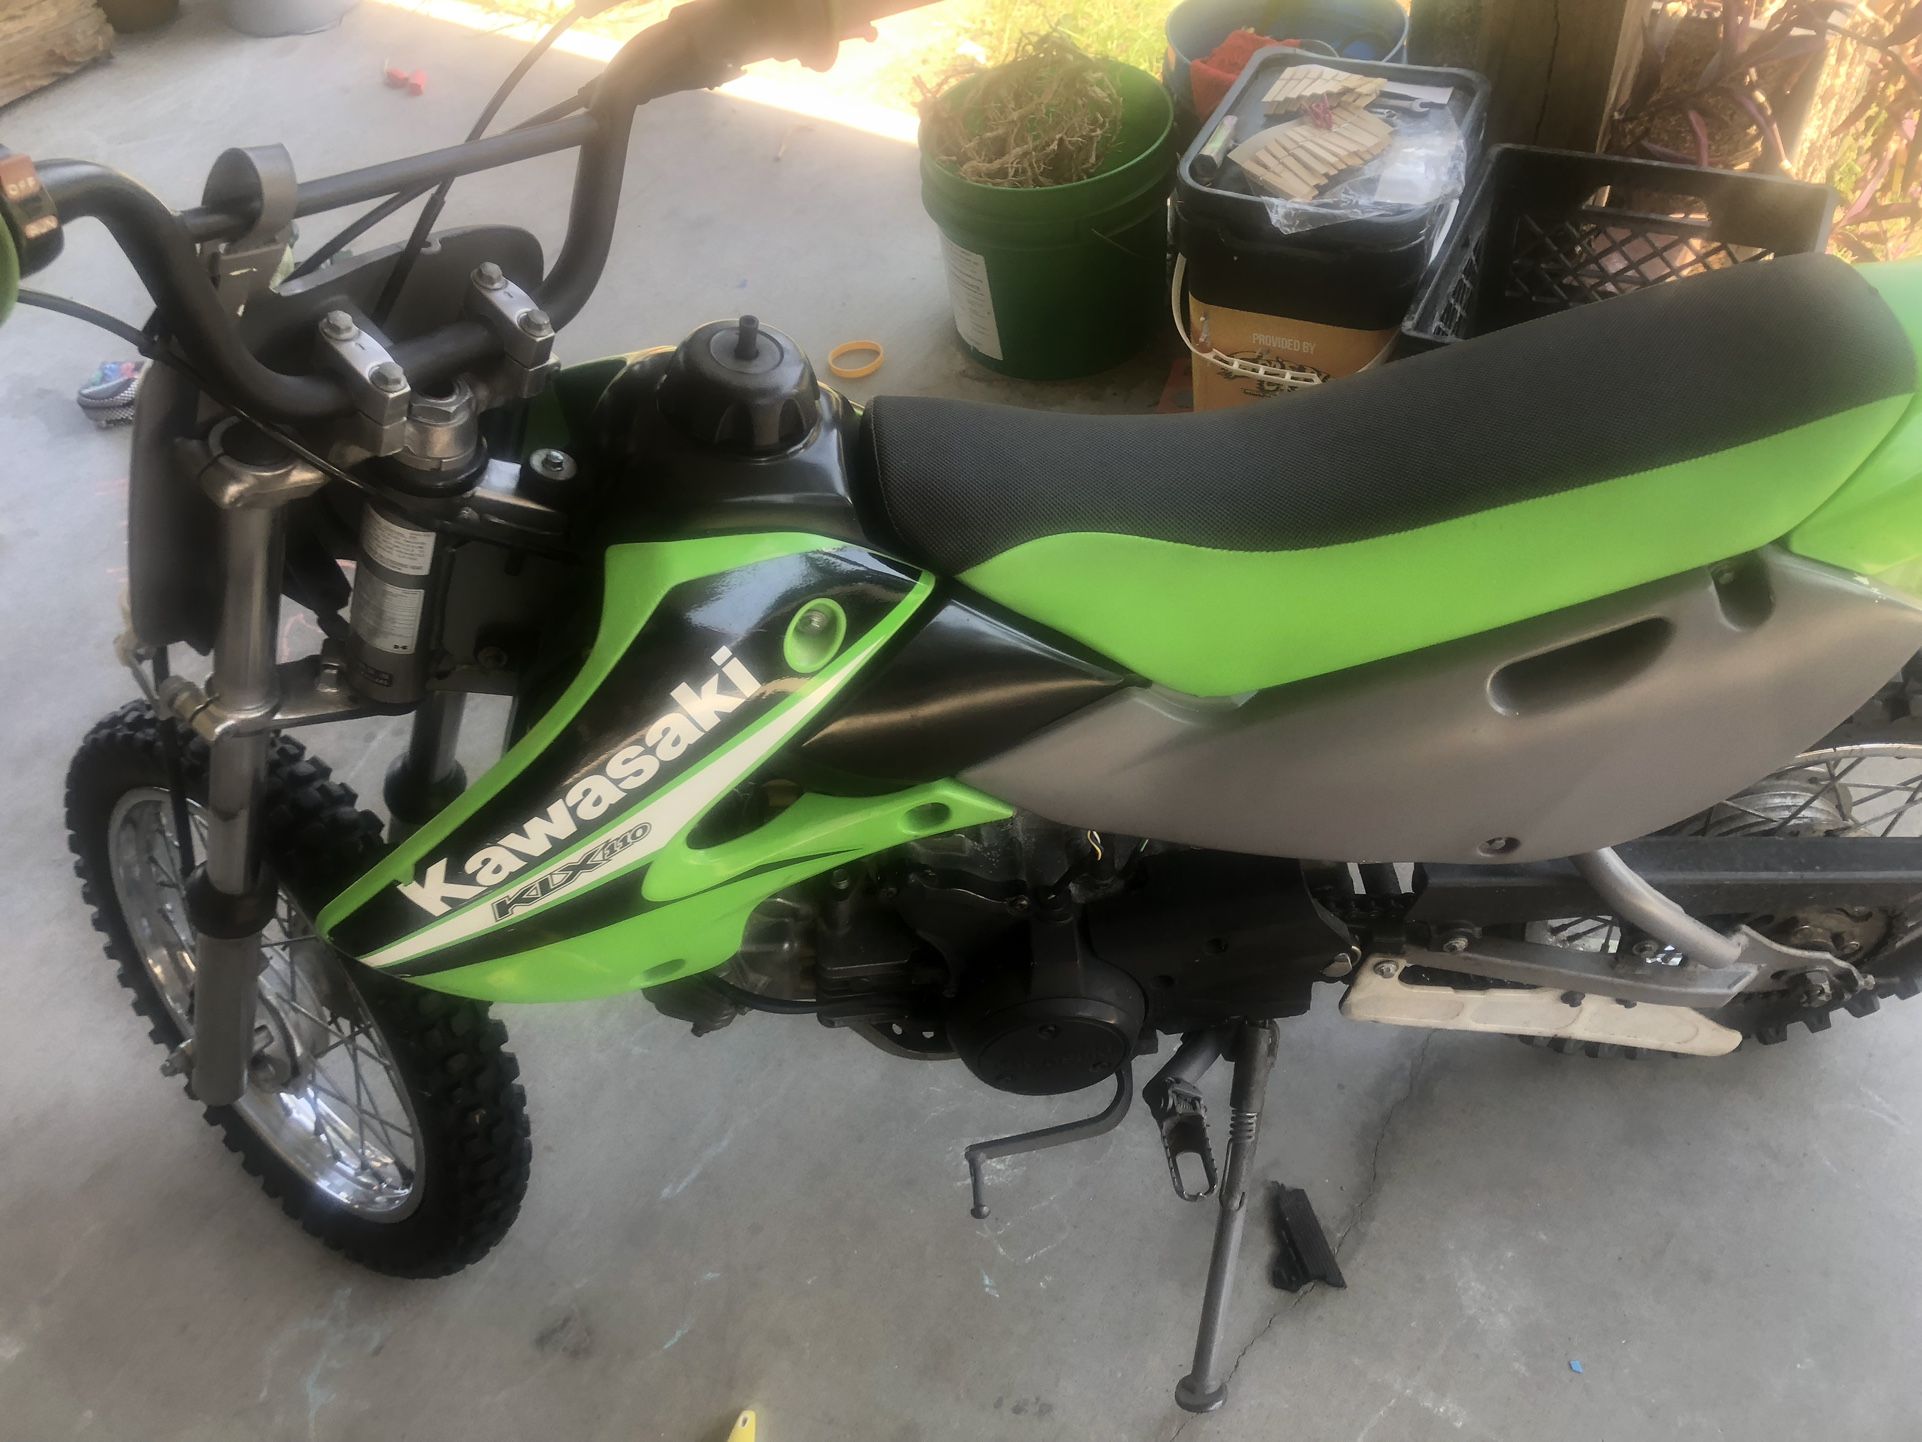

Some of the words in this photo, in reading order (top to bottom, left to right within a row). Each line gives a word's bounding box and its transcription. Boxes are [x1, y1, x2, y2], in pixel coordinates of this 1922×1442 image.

[9, 177, 35, 195] OFF
[1253, 333, 1300, 351] PROVIDED
[1303, 342, 1316, 354] BY
[397, 645, 762, 917] Kawasaki
